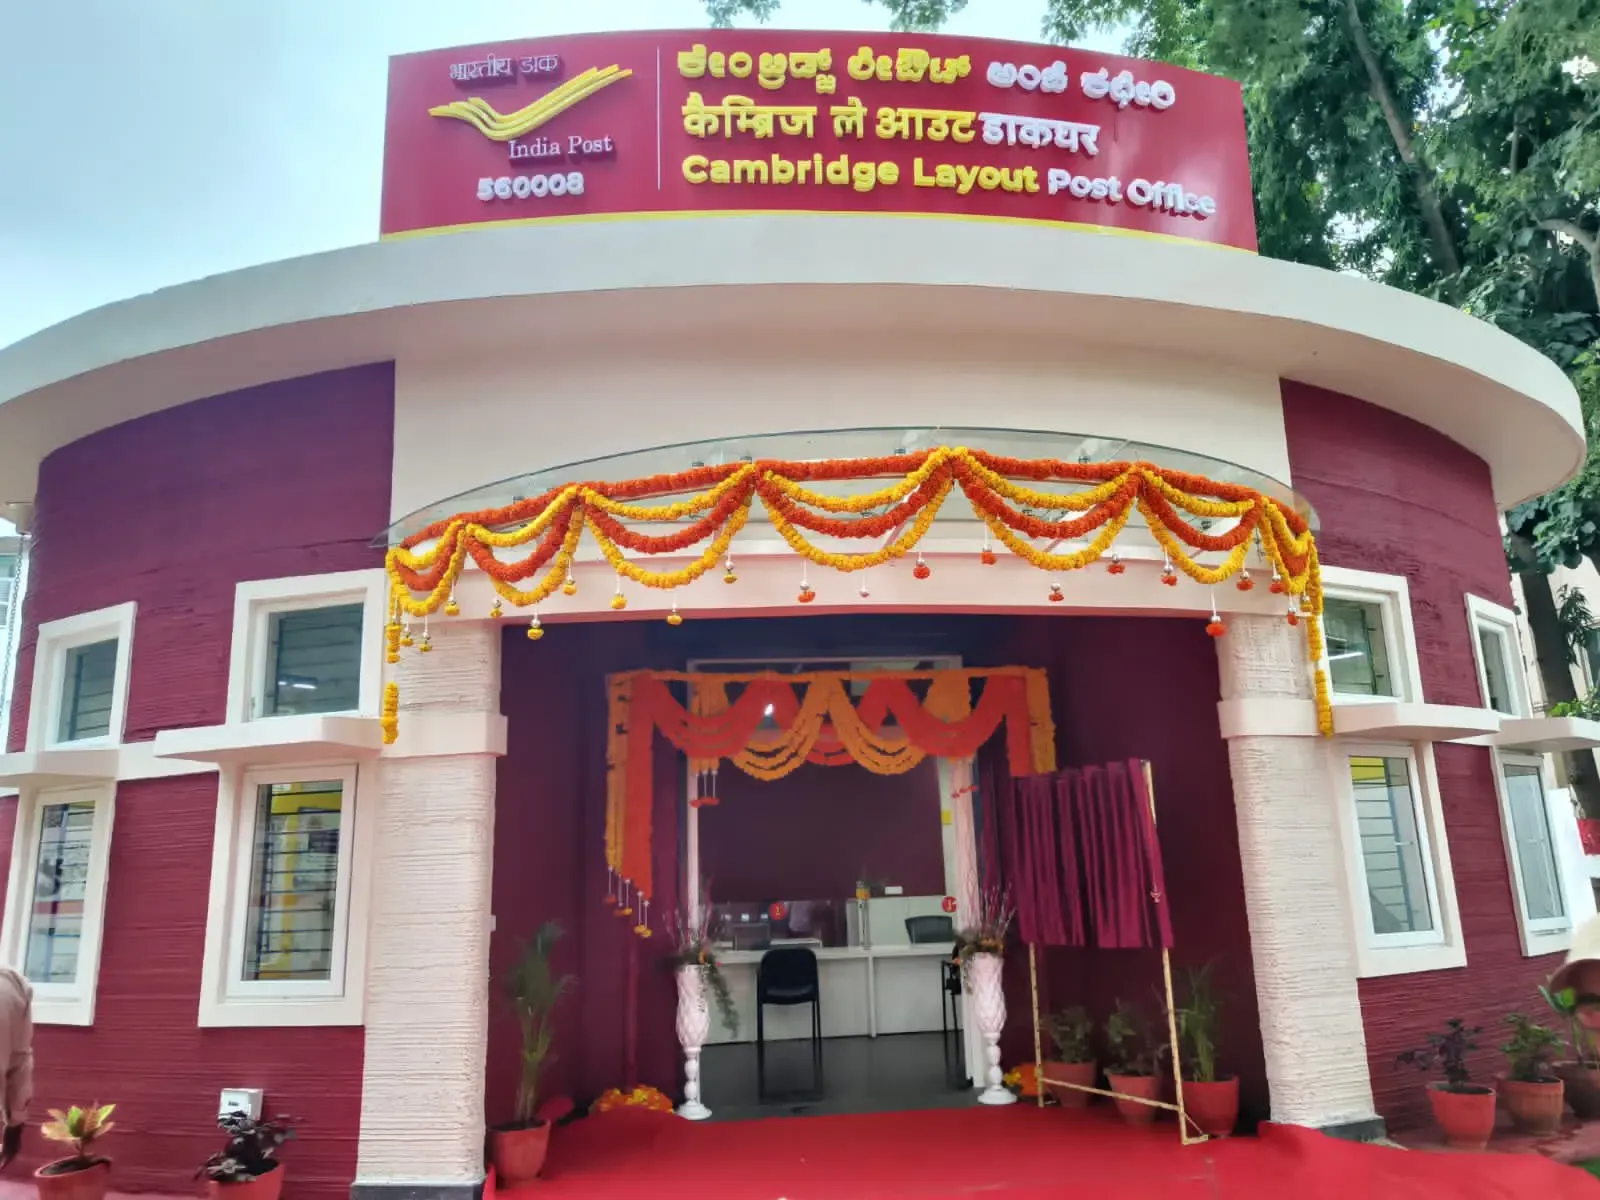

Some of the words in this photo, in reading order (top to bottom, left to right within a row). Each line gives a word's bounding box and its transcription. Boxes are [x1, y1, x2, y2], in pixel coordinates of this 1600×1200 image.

[520, 55, 559, 73] डाक
[986, 60, 1068, 93] ಅಂಚೆ
[875, 106, 977, 142] आउट
[978, 112, 1101, 155] डाकघर
[508, 136, 561, 160] India
[567, 135, 613, 155] Post
[477, 171, 585, 201] 560008
[681, 154, 900, 192] Cambridge
[913, 157, 1040, 195] Layout
[1047, 167, 1123, 202] Post
[1127, 178, 1217, 218] Office
